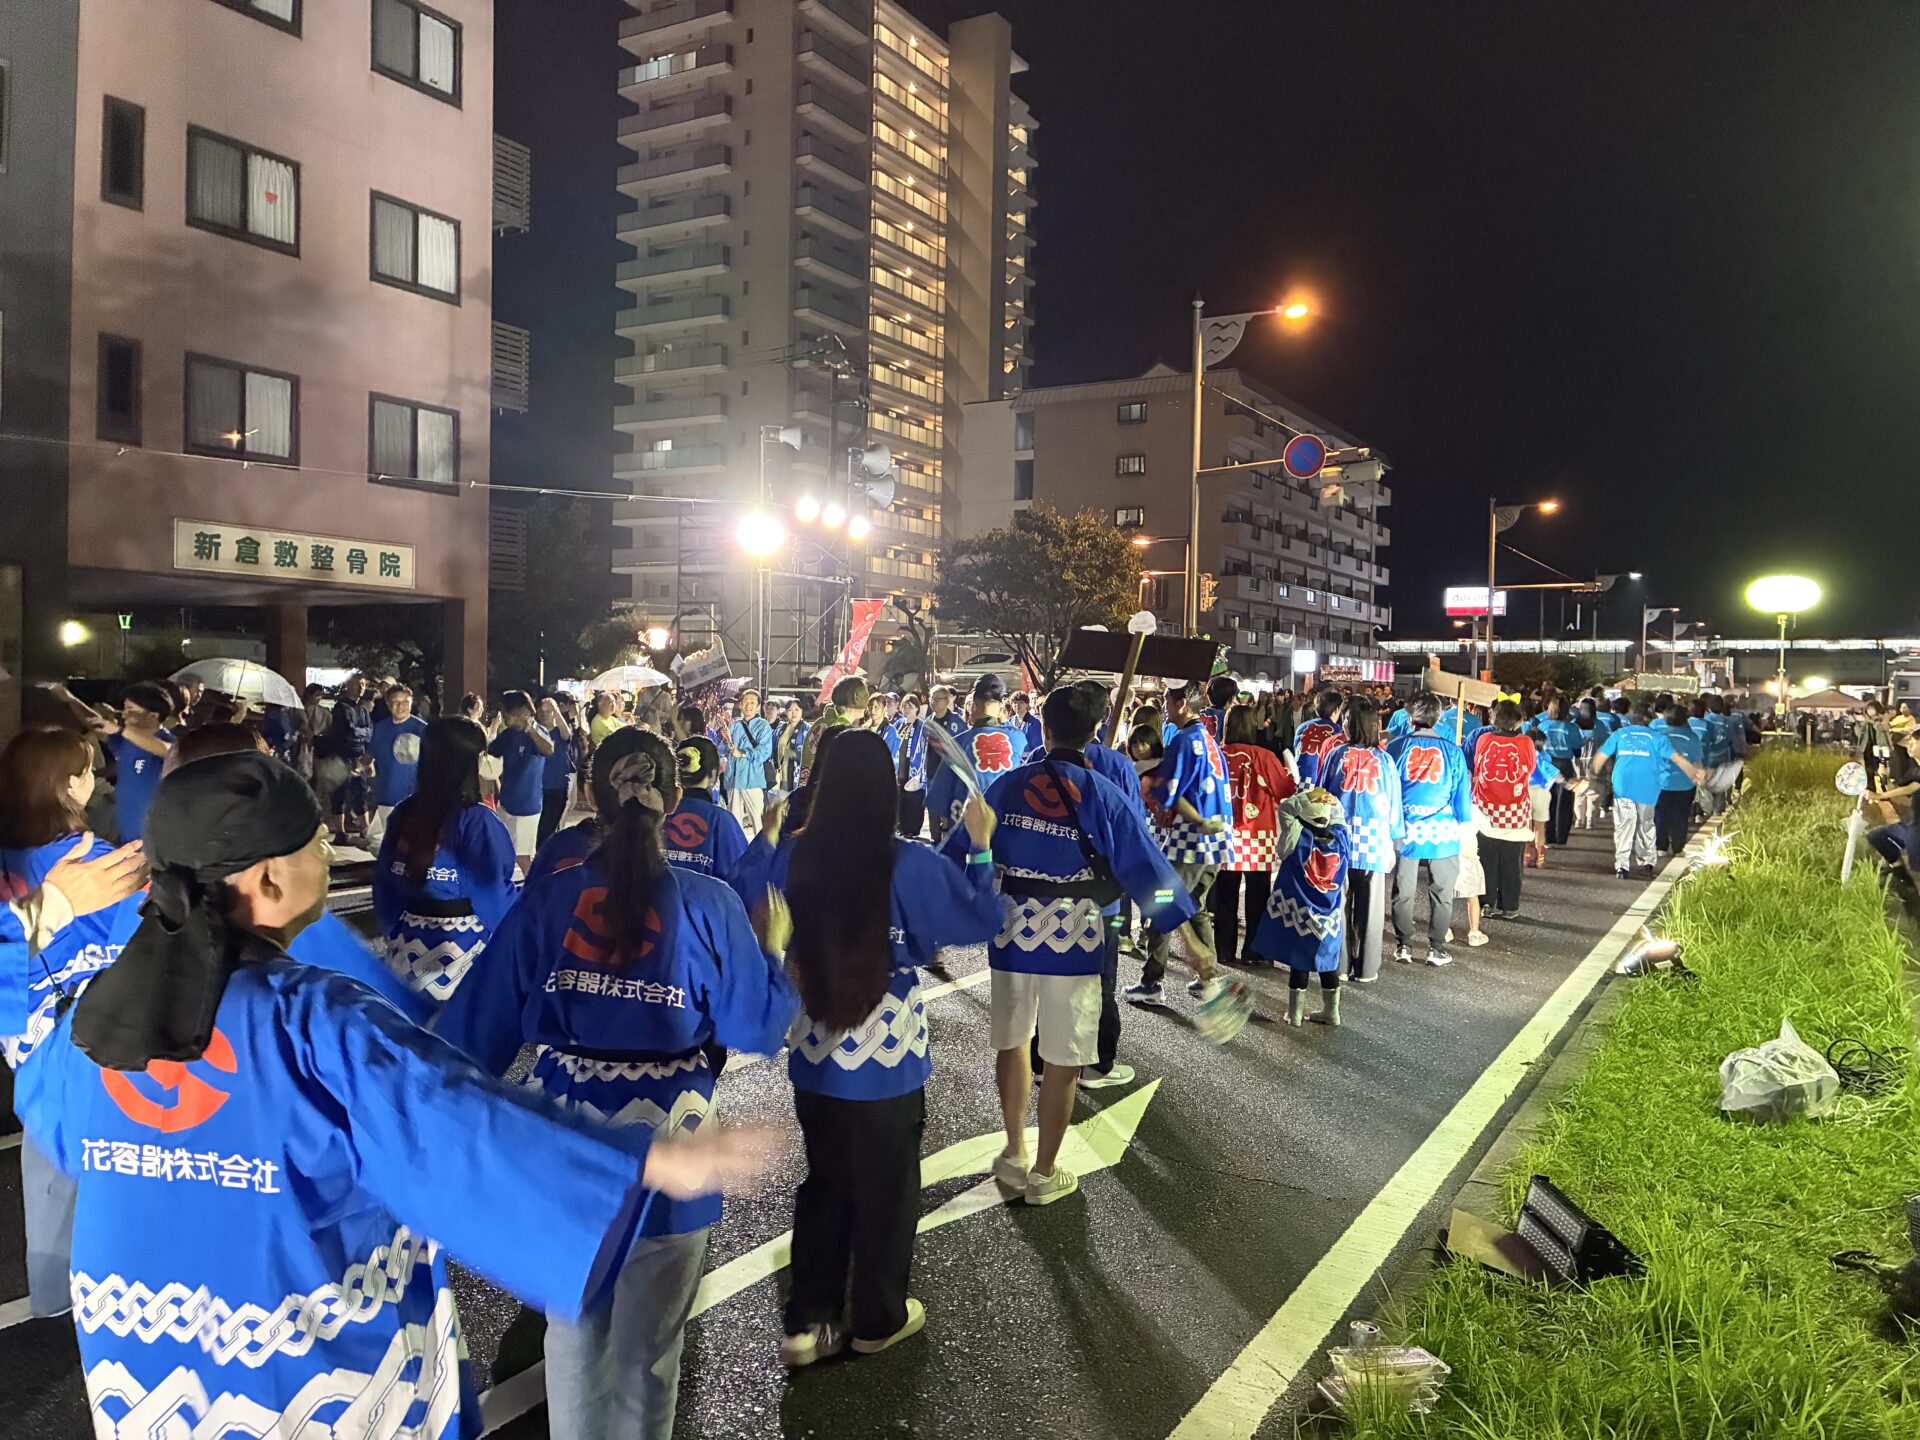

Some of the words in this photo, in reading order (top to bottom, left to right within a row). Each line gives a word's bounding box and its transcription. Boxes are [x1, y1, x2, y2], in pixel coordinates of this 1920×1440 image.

[194, 531, 401, 577] 新倉敷整骨院
[972, 732, 1013, 773] 祭
[1482, 741, 1519, 783] 祭
[1002, 813, 1094, 840] 花容器株式会
